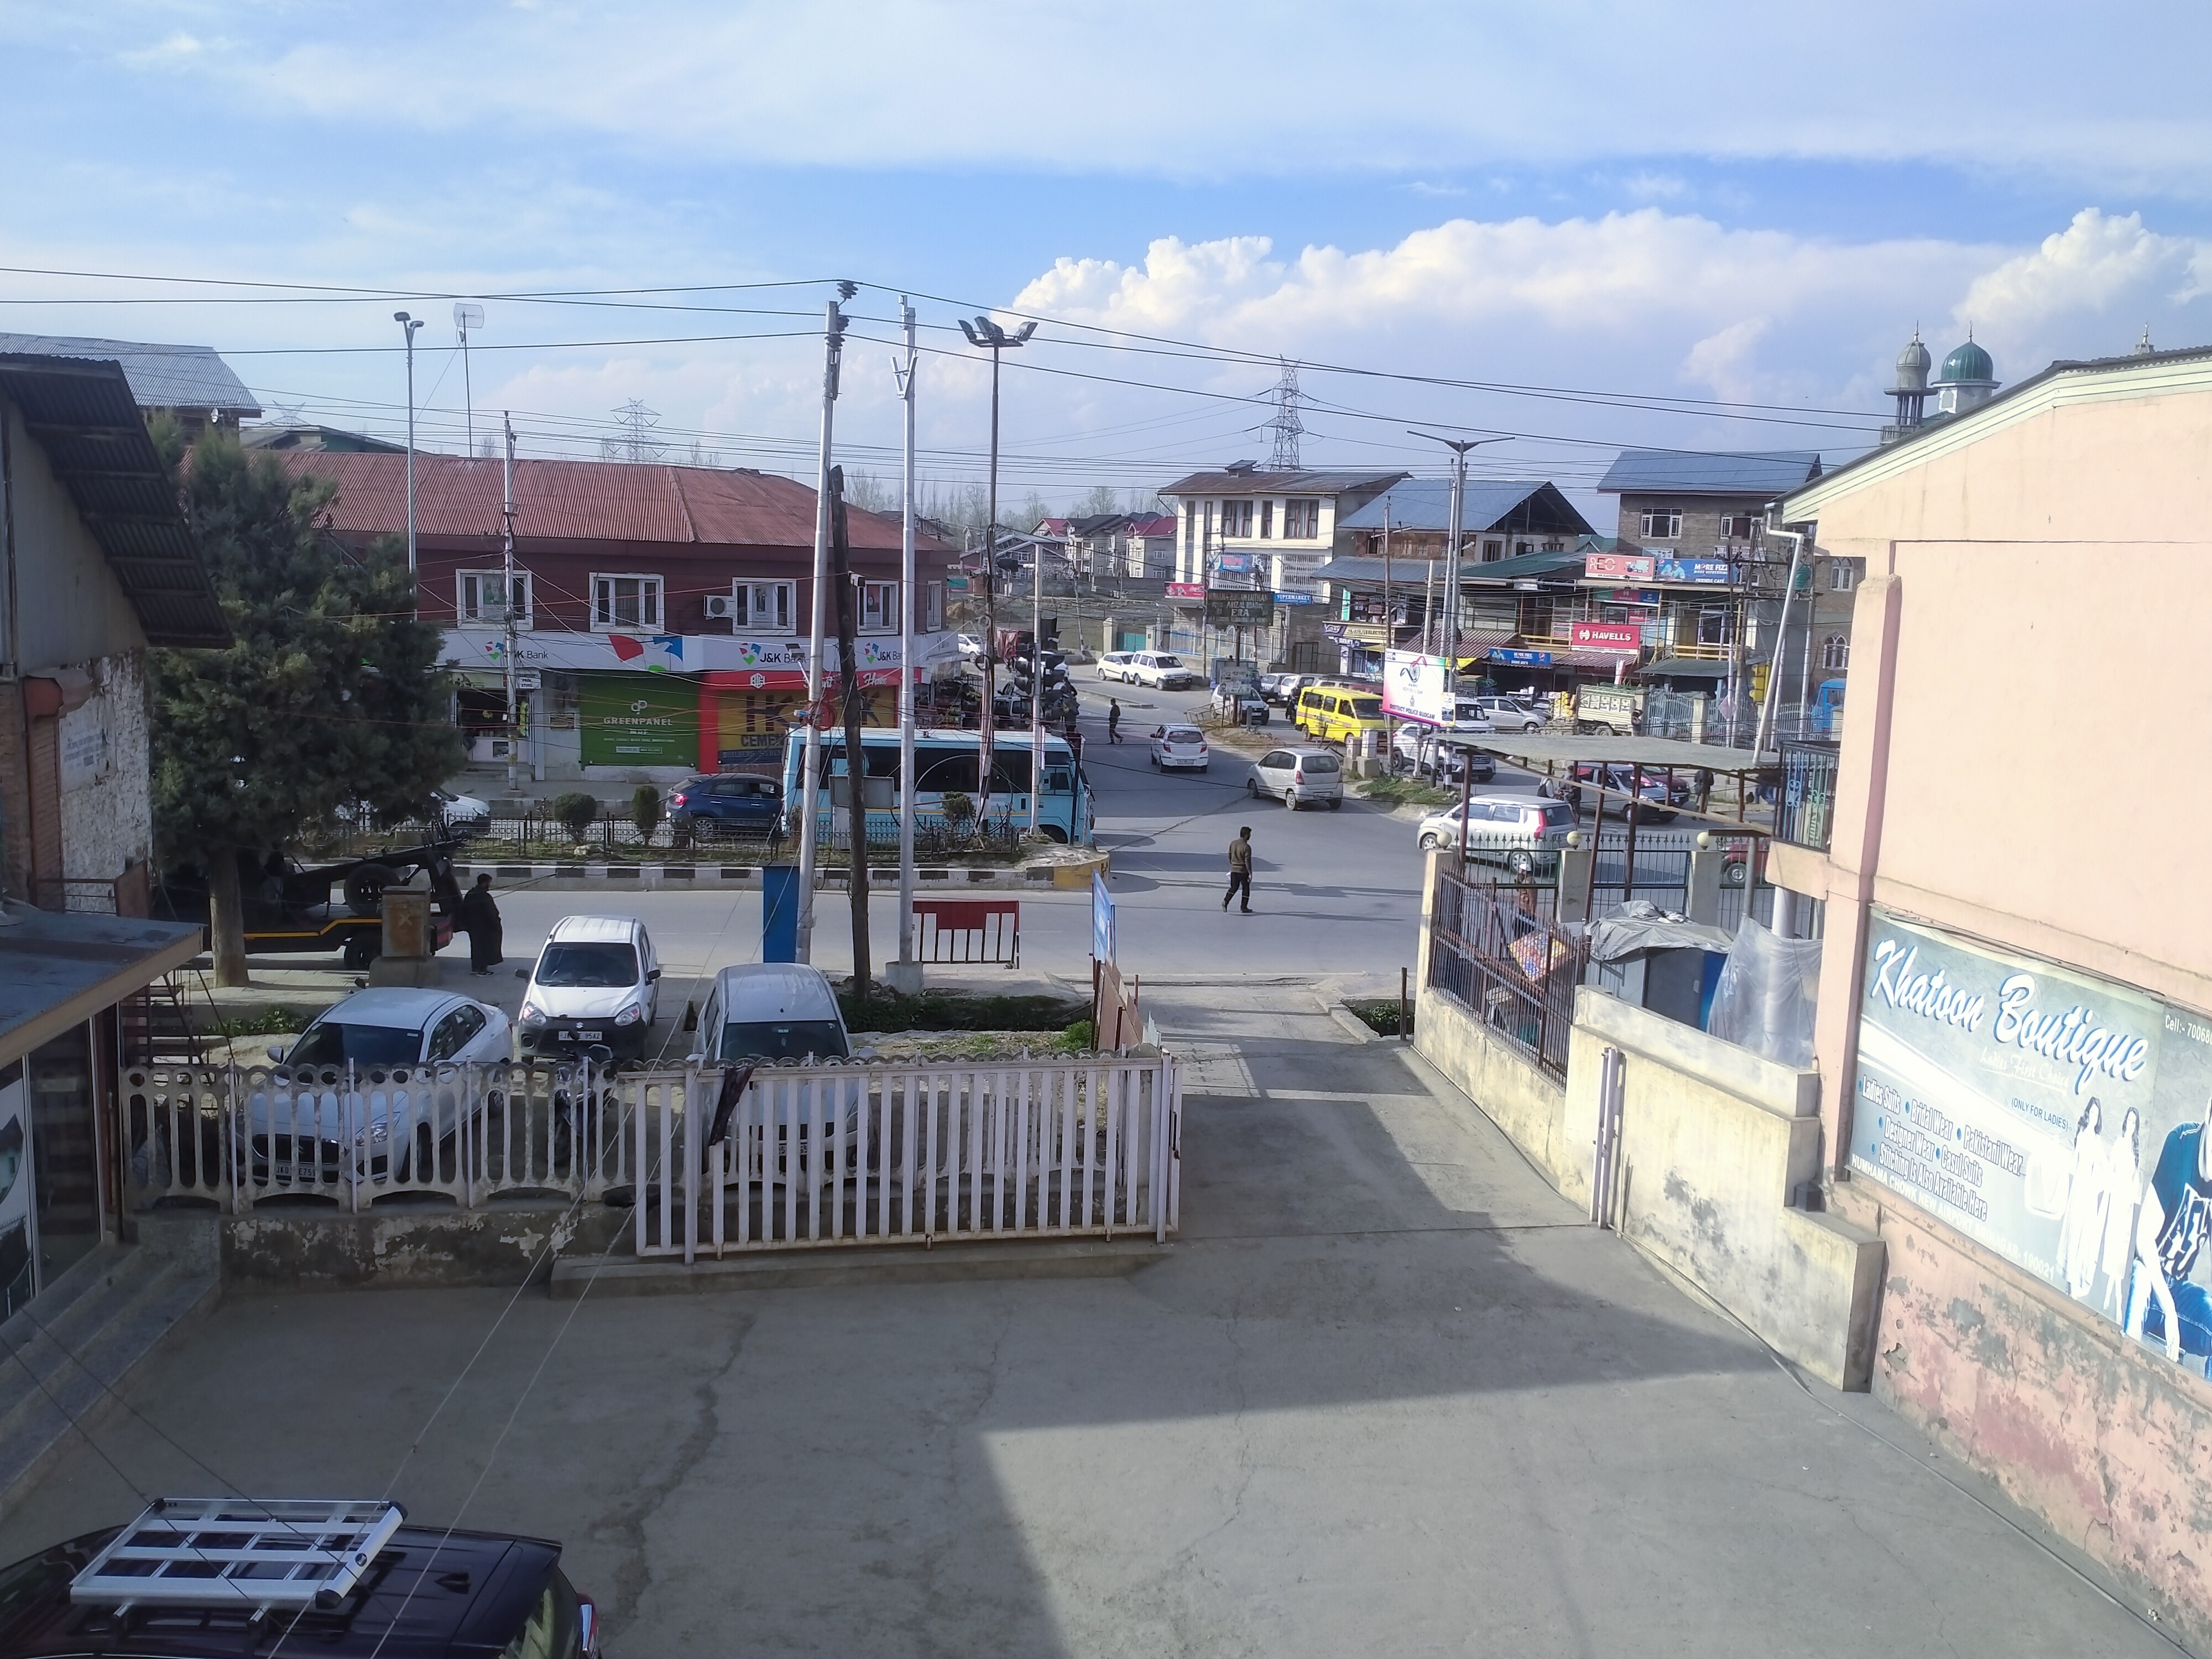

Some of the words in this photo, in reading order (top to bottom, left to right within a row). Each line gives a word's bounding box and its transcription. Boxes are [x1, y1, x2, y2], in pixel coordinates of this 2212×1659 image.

[1231, 608, 1250, 617] ERA
[1592, 631, 1632, 641] HAVELLS
[526, 650, 549, 659] Bank
[760, 653, 781, 663] J&K
[877, 651, 891, 661] J&K
[603, 717, 674, 726] GREENPANEL
[1389, 703, 1405, 712] DISTRICT
[1406, 708, 1418, 716] POLICE
[1870, 940, 1985, 1032] Khatoon
[1993, 974, 2149, 1095] Boutique
[1979, 1046, 2007, 1070] Ladies
[2010, 1054, 2036, 1078] First
[2039, 1062, 2070, 1088] Choice
[1861, 1074, 1884, 1106] Ladies
[1884, 1086, 1901, 1115] Suits
[1910, 1098, 1933, 1131] Bridal
[1932, 1109, 1953, 1141] Wear
[1963, 1124, 2001, 1165] Pakistani
[2000, 1142, 2023, 1177] Wear
[2011, 1097, 2030, 1112] (ONLY
[2030, 1104, 2043, 1120] FOR
[2044, 1110, 2068, 1132] LADIES)
[1884, 1115, 1916, 1149] Designer
[1915, 1131, 1935, 1161] Wear
[1941, 1145, 1963, 1177] Casul
[1963, 1156, 1983, 1187] Suits
[1879, 1142, 1910, 1181] Stitching
[1909, 1157, 1918, 1183] Is
[1917, 1162, 1934, 1192] Also
[1933, 1171, 1969, 1212] Available
[1968, 1189, 1987, 1222] Here
[1851, 1154, 1888, 1185] HUMHAMA
[1889, 1175, 1917, 1201] CHOWK
[1918, 1191, 1937, 1212] NEW
[1938, 1202, 1973, 1232] AIRPORT
[2023, 1250, 2054, 1281] 190021
